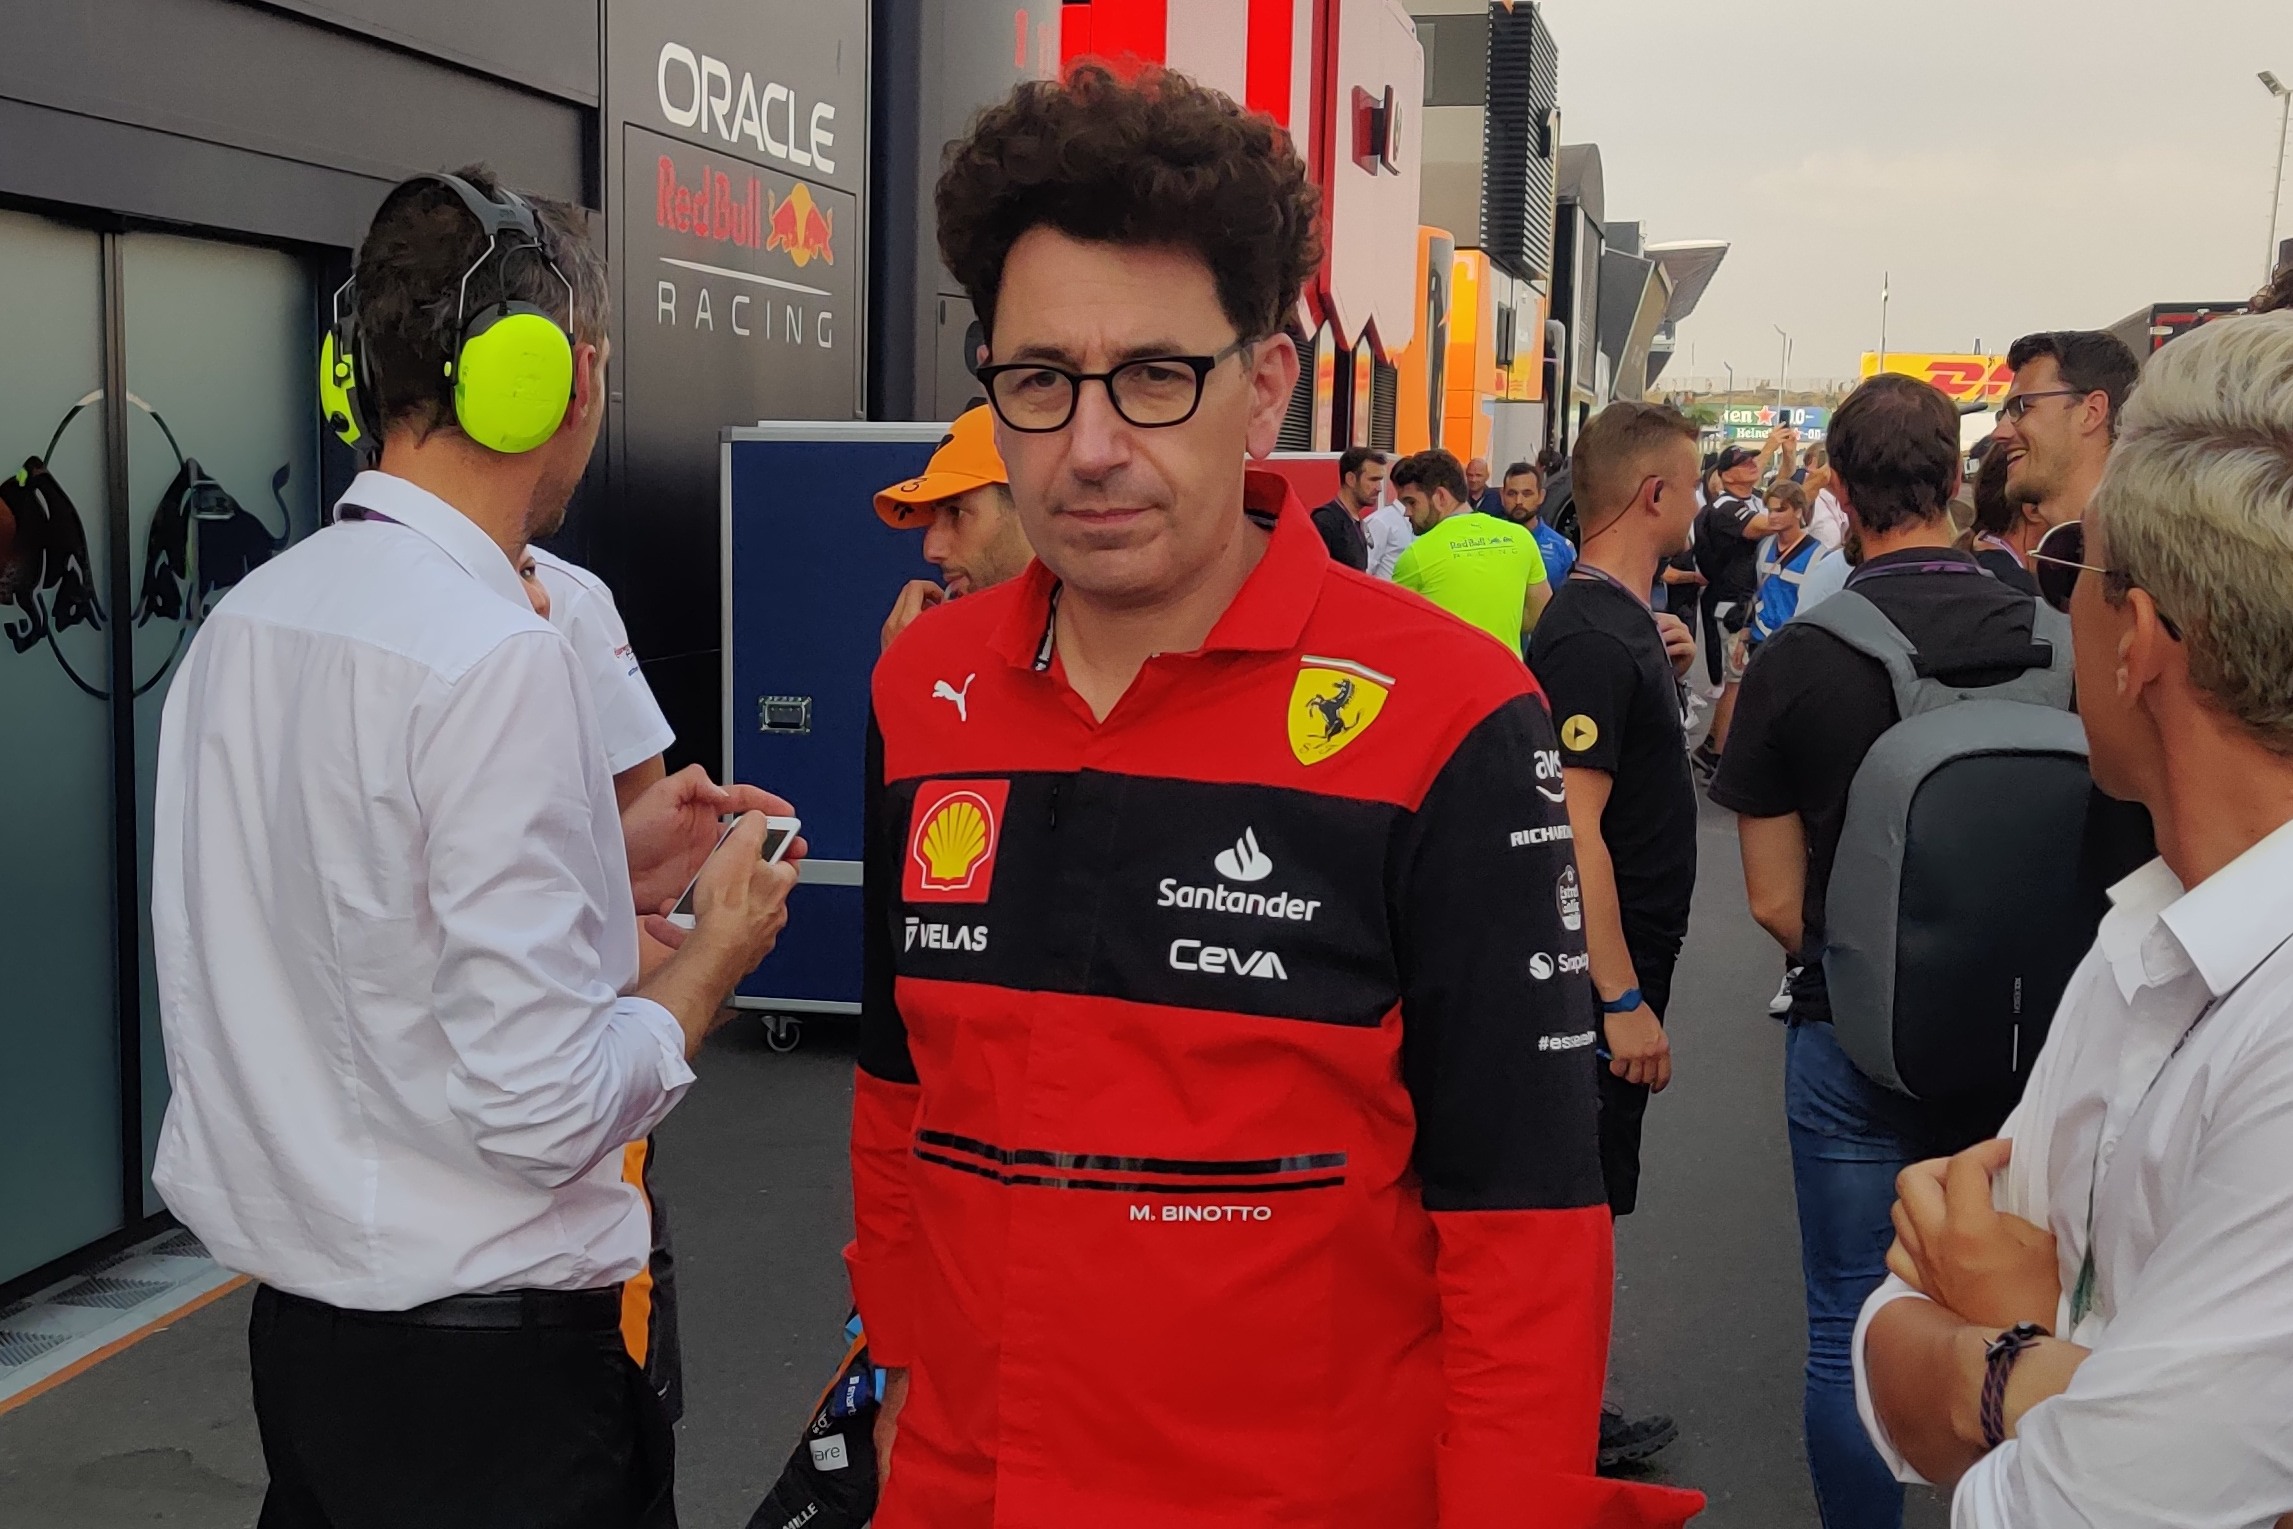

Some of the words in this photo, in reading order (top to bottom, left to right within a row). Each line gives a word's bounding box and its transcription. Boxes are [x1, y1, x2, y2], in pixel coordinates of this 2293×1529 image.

[658, 42, 835, 174] ORACLE
[658, 281, 832, 348] RACING
[1736, 427, 1772, 439] Heine
[1157, 878, 1321, 921] Santander
[920, 924, 989, 951] VELAS
[1129, 1204, 1156, 1221] M.
[1161, 1205, 1272, 1222] BINOTTO
